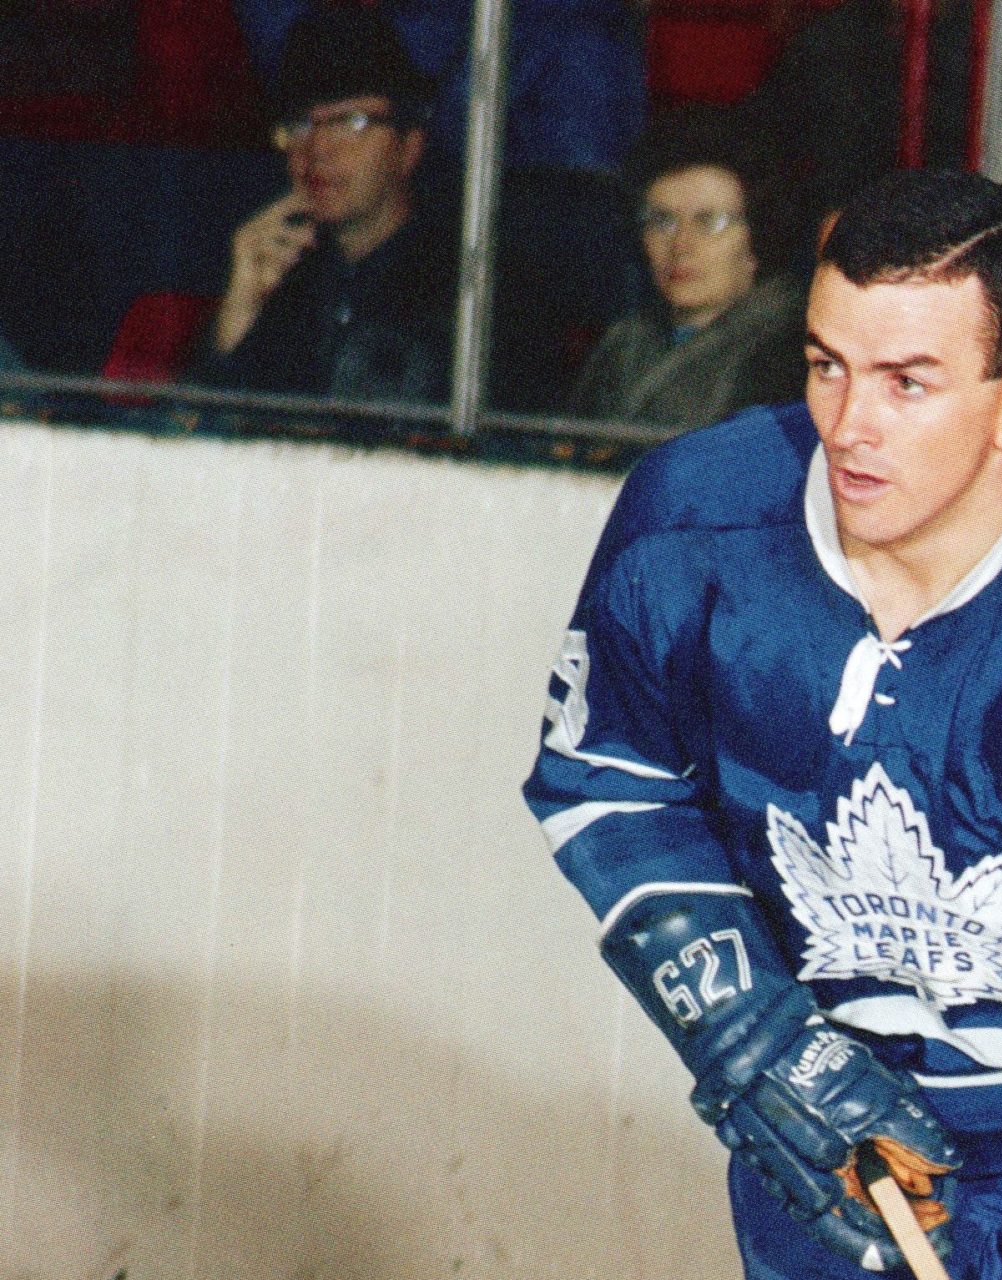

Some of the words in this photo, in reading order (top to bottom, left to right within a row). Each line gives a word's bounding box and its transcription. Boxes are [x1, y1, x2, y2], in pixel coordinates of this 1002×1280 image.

[823, 893, 985, 936] TORONTO
[853, 921, 962, 948] MAPLE
[652, 928, 753, 1024] 627
[853, 942, 975, 973] LEAFS
